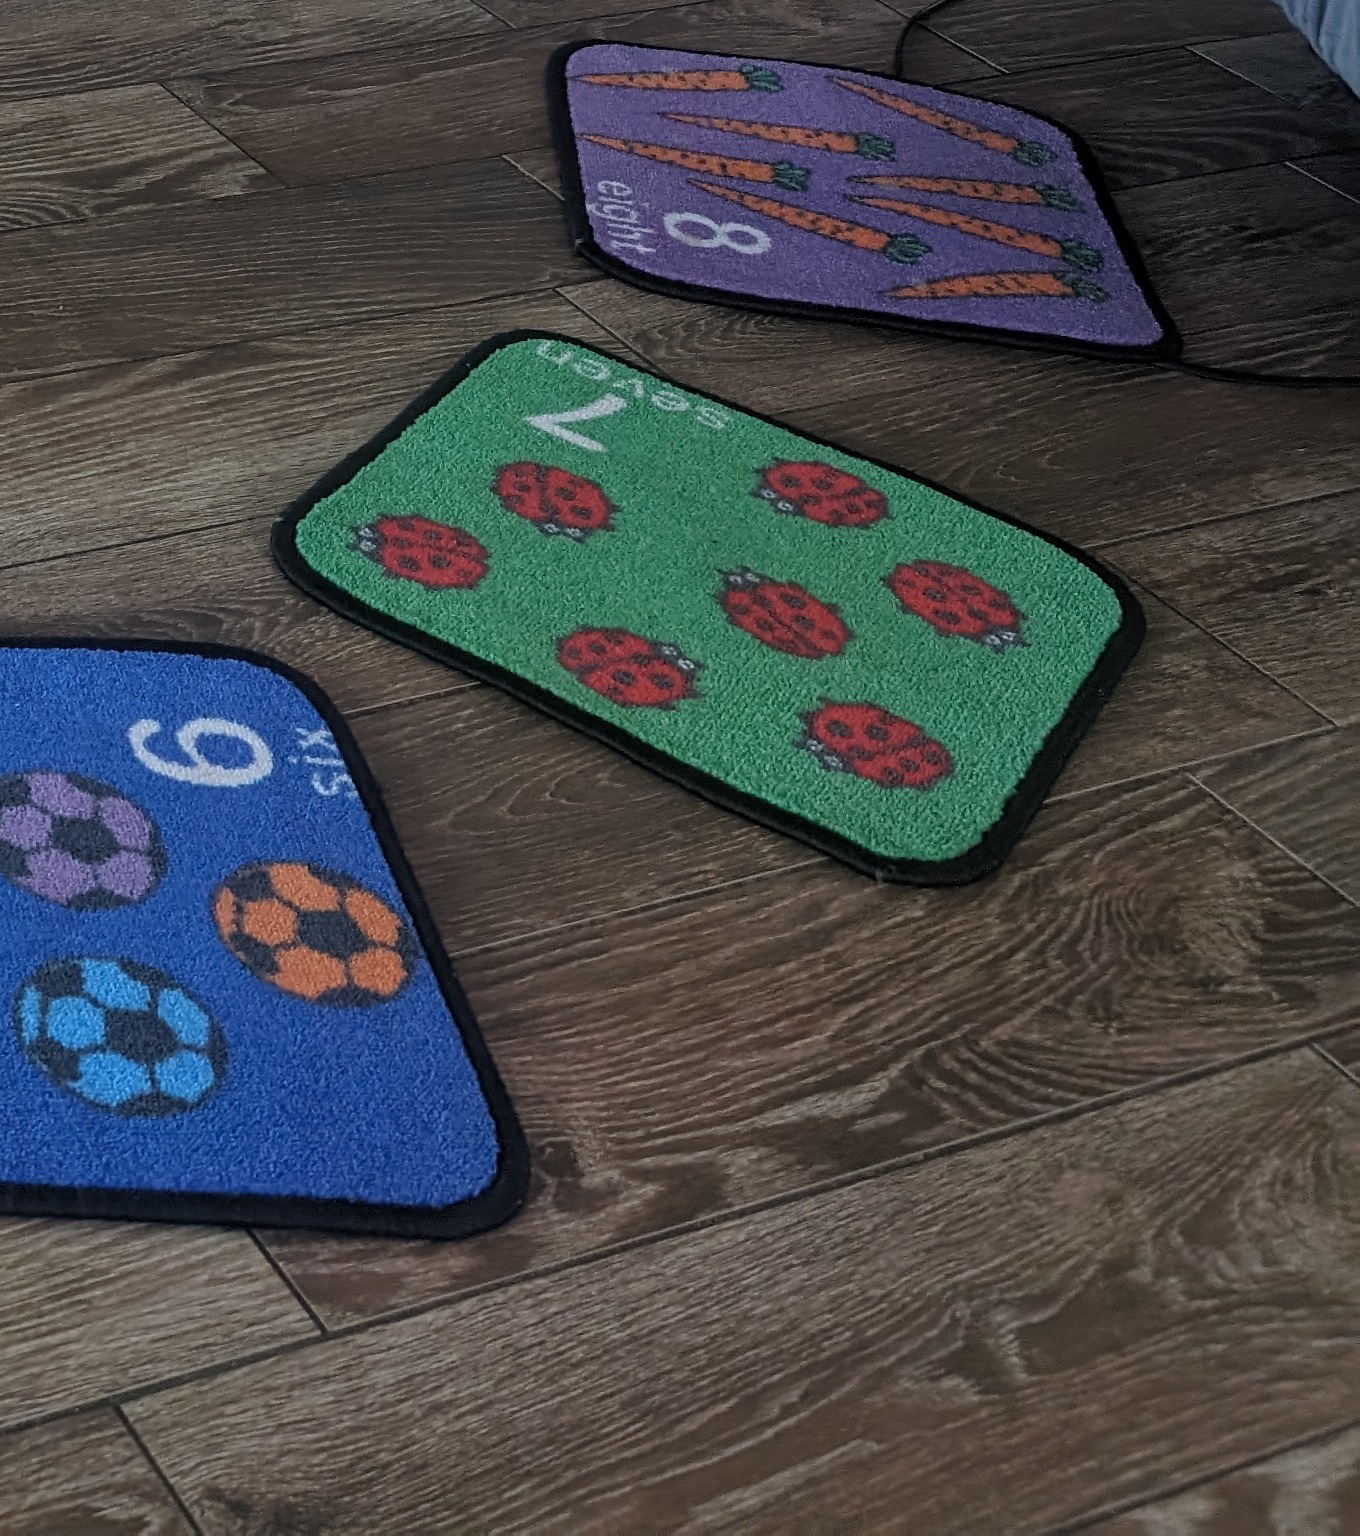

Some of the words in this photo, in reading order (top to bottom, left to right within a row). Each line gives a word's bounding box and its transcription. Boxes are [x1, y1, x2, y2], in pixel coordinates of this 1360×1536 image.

[585, 180, 656, 254] eight
[664, 212, 771, 254] 8
[537, 340, 729, 429] seven
[524, 393, 628, 452] 7
[288, 727, 359, 799] six
